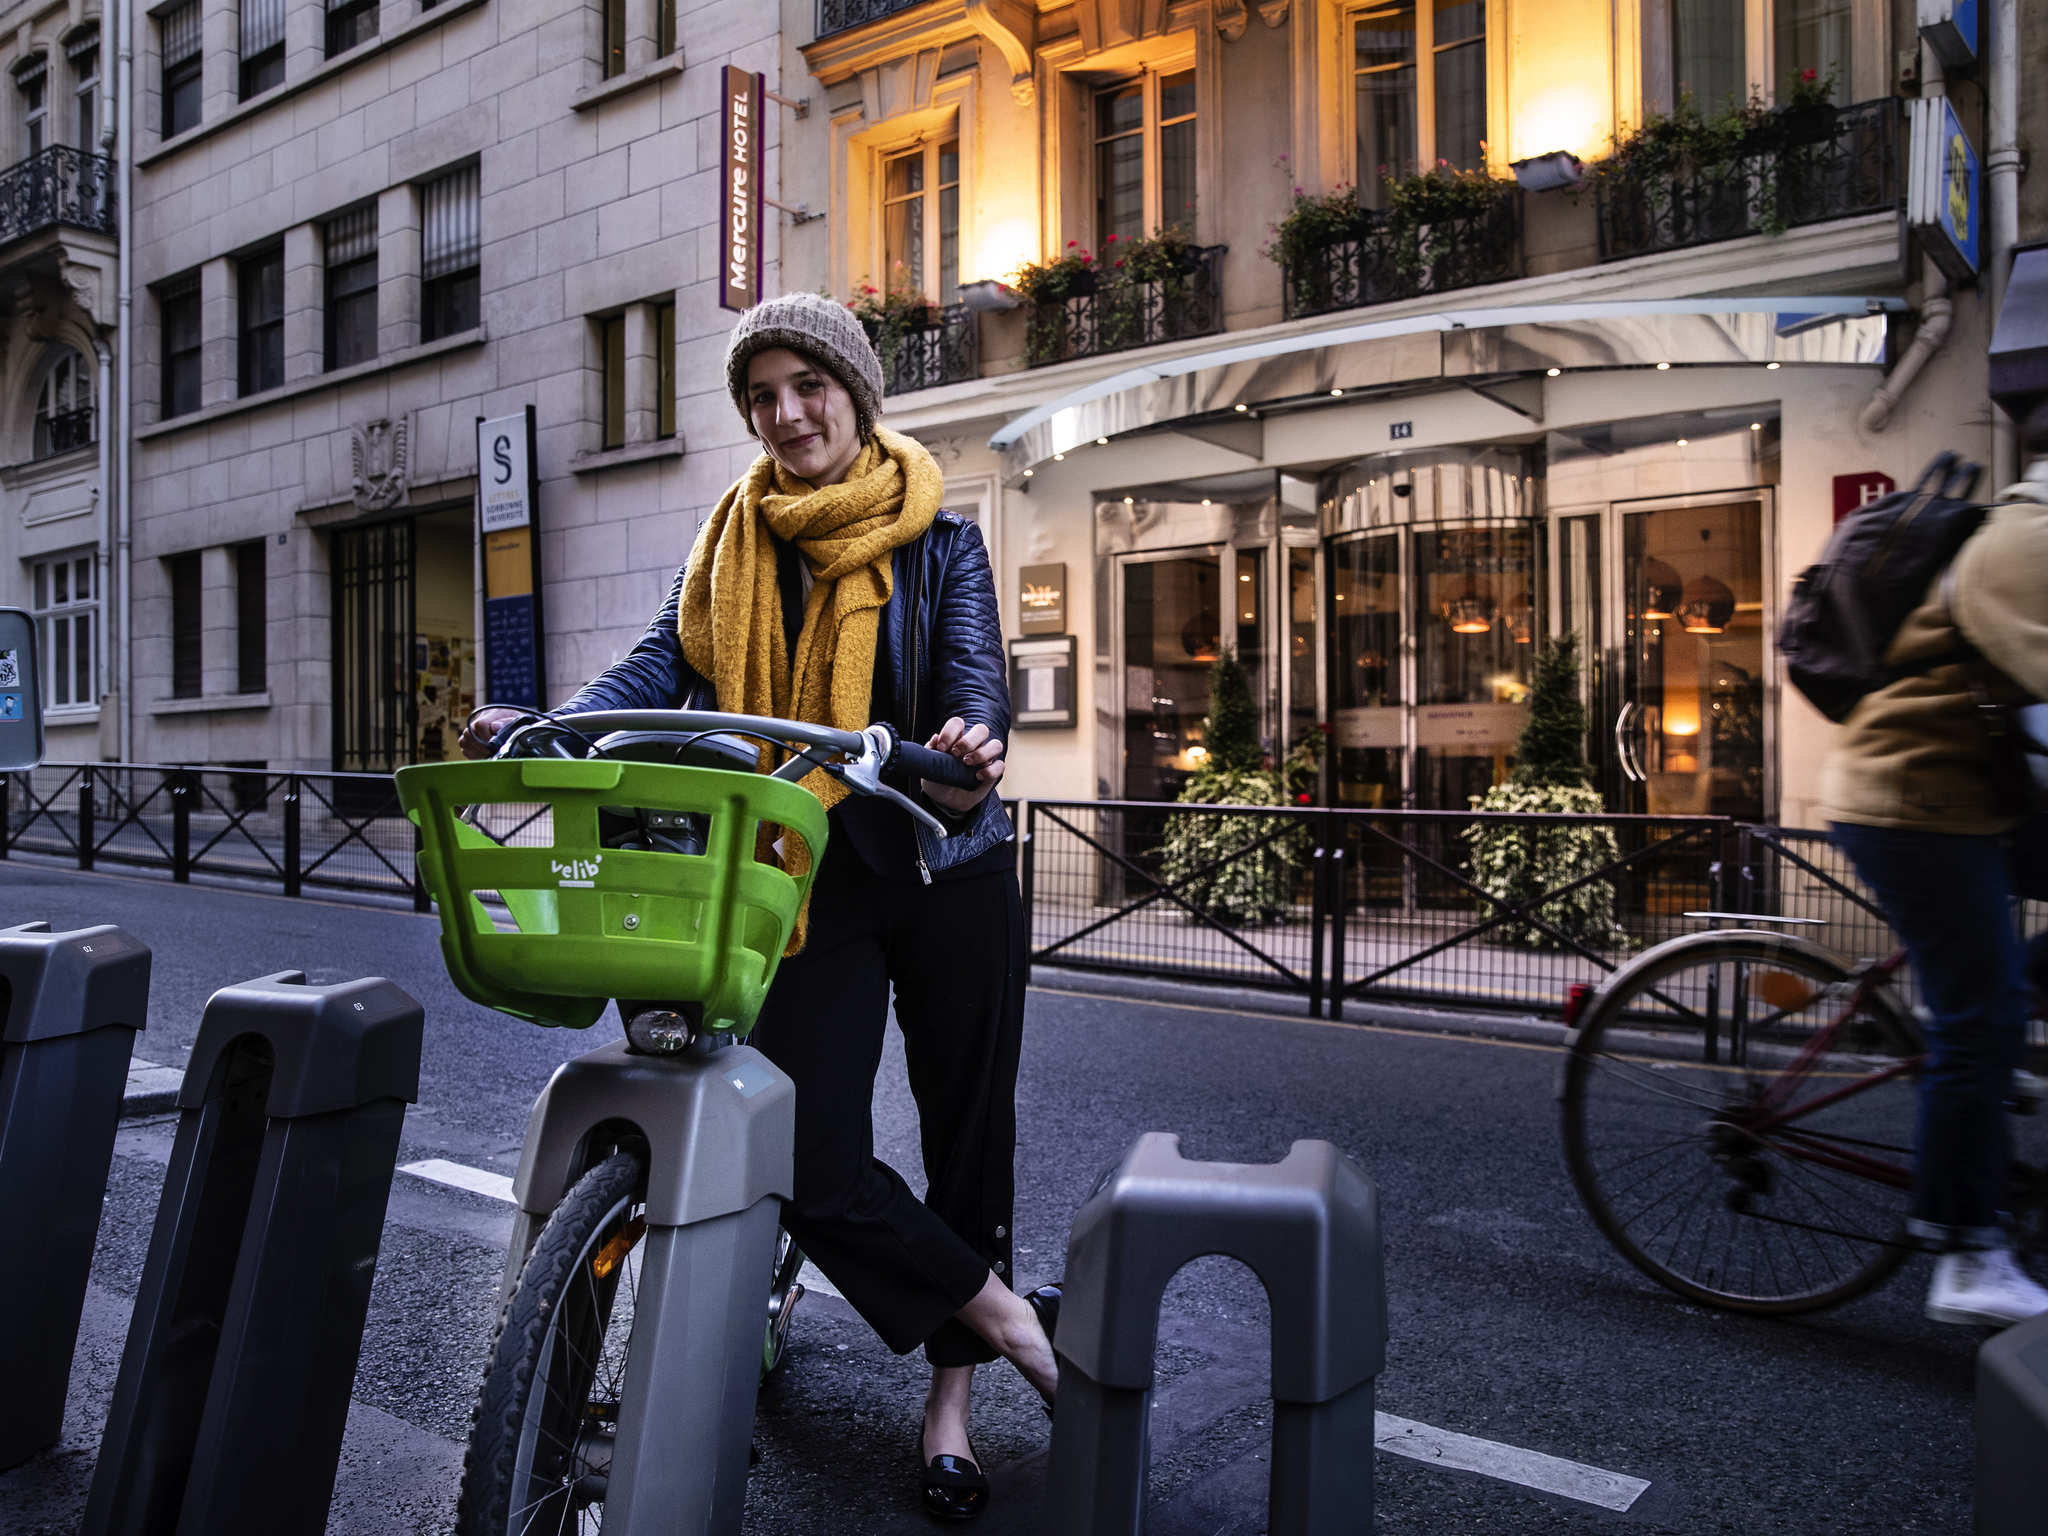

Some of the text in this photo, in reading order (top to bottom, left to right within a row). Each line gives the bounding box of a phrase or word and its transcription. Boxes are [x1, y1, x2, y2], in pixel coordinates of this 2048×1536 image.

[730, 91, 748, 290] Mercure HOTEL
[1860, 483, 1884, 506] H
